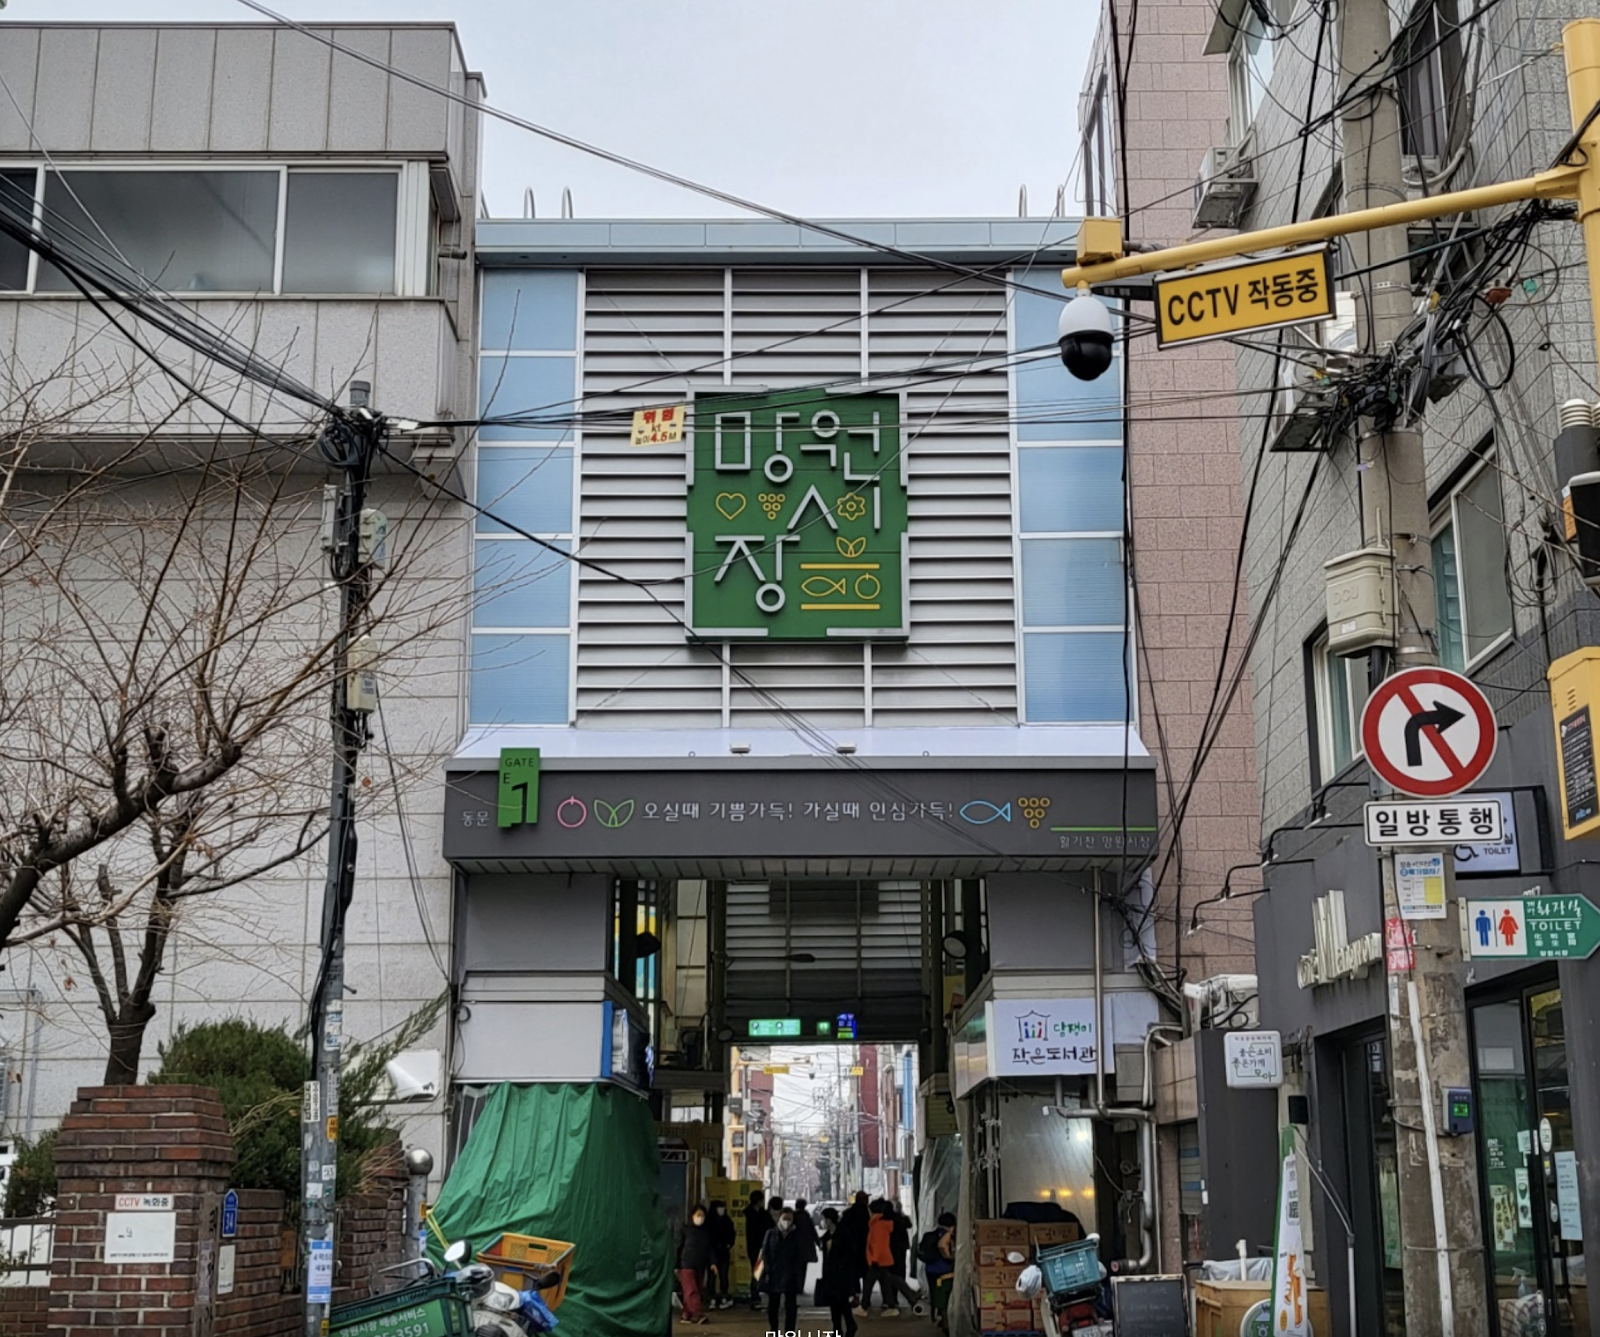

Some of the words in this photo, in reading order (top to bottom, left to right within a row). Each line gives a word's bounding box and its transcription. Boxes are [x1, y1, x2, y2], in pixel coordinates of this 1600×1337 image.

[1168, 284, 1239, 325] CCTV
[1248, 269, 1318, 310] 작동중
[643, 408, 675, 424] 위험
[504, 757, 535, 767] GATE
[503, 773, 511, 784] E
[511, 782, 529, 823] 1
[461, 811, 489, 827] 동문
[642, 802, 699, 820] 오실때
[709, 802, 794, 821] 기쁨가득!
[803, 802, 860, 821] 가실때
[1375, 808, 1493, 837] 일방통행
[1060, 836, 1095, 849] 활기찬
[1102, 836, 1150, 849] 망원시장
[1484, 847, 1512, 855] TOILET
[1537, 899, 1582, 918] 화장실
[1530, 921, 1581, 931] TOILET
[1012, 1046, 1097, 1065] 작은도서관
[118, 1197, 141, 1207] CCTV
[143, 1197, 170, 1207] 녹화중
[379, 1308, 427, 1328] 배송서비스
